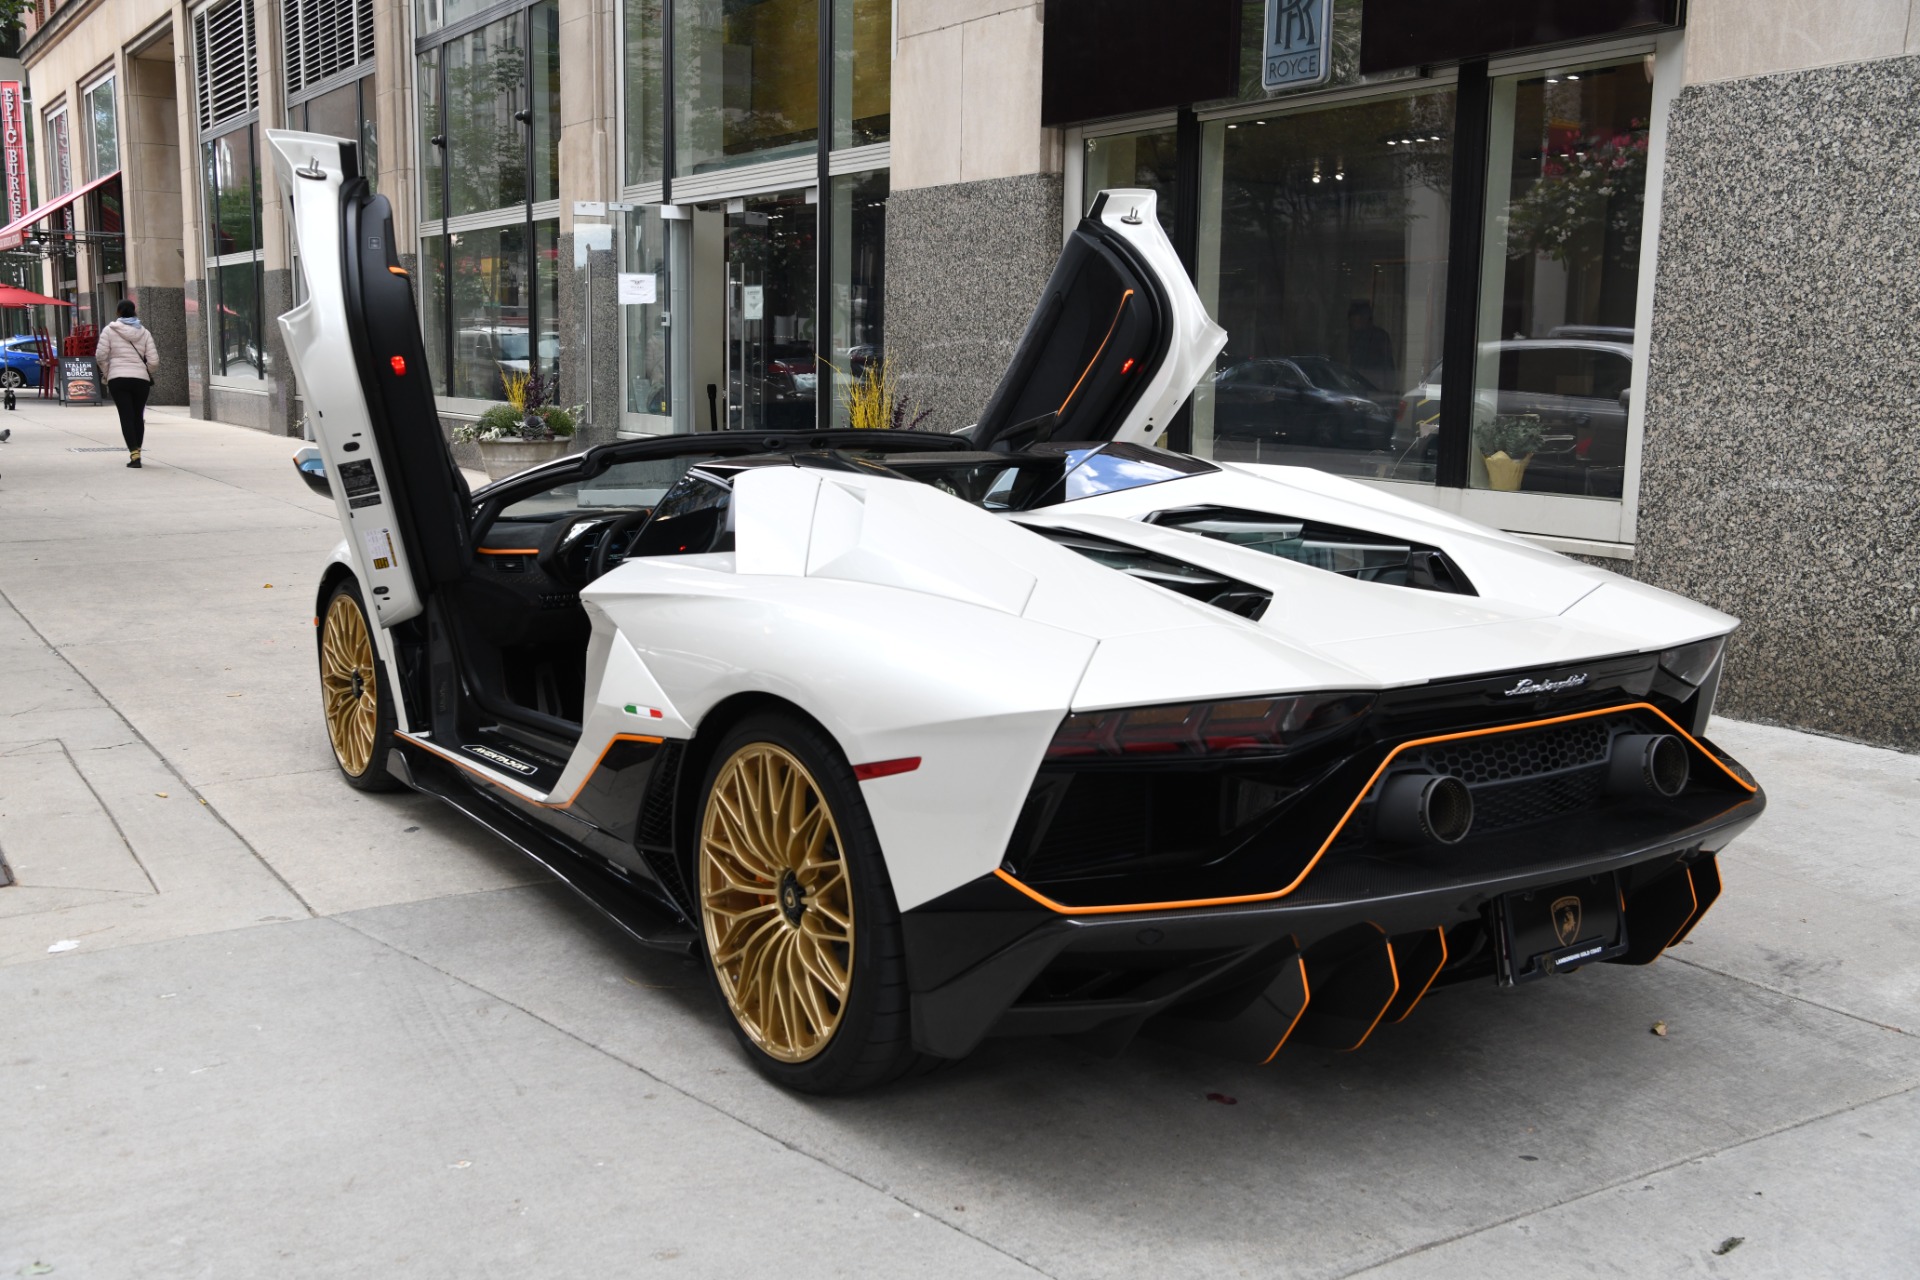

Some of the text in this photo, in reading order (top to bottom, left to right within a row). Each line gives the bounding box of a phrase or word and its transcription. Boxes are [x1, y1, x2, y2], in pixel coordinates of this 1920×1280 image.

[1268, 55, 1316, 79] ROYCE
[4, 88, 17, 144] EPIC
[1504, 672, 1588, 696] Lamborghini
